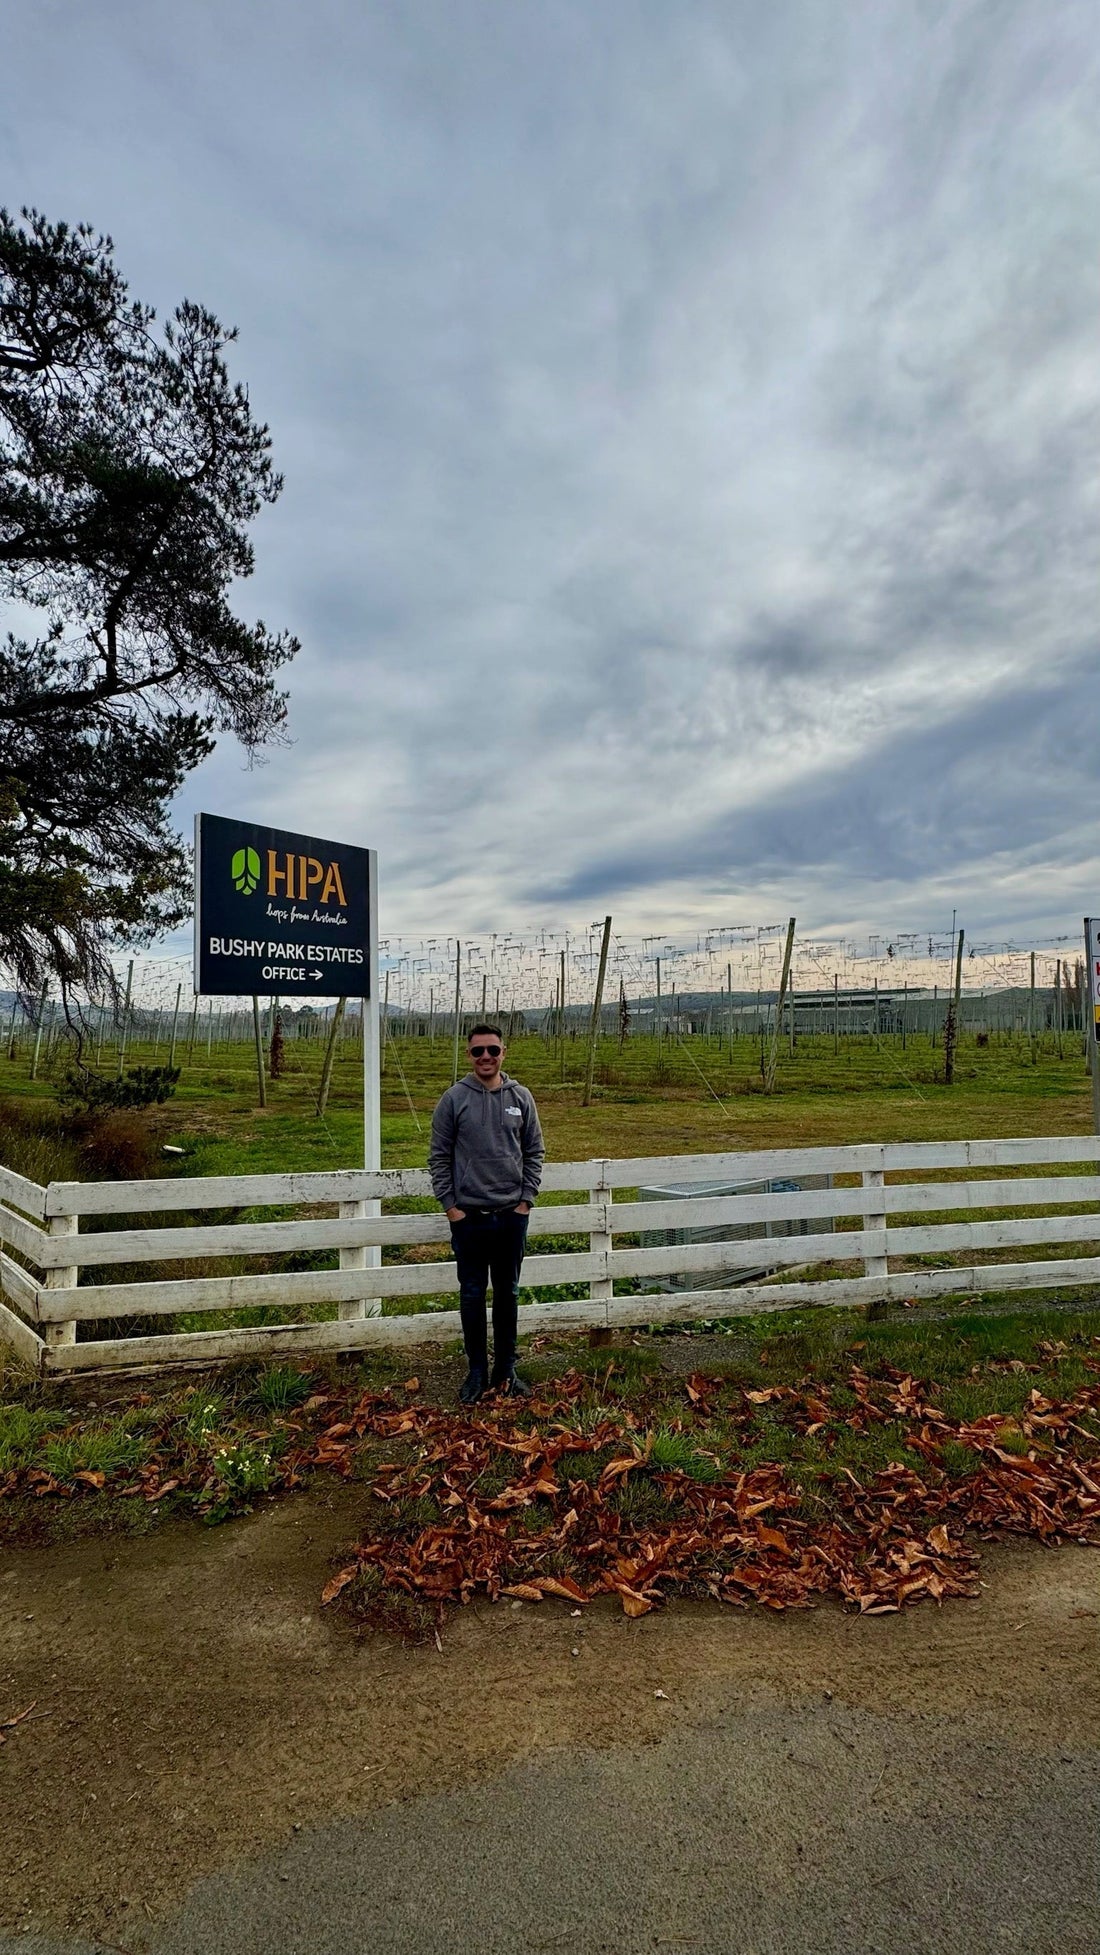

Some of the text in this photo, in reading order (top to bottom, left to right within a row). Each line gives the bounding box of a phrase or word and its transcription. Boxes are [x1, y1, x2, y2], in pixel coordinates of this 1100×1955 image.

[267, 849, 348, 906] HPA
[266, 903, 348, 925] hops from Australia
[210, 937, 364, 964] BUSHY PARK ESTATES
[262, 965, 306, 981] OFFICE
